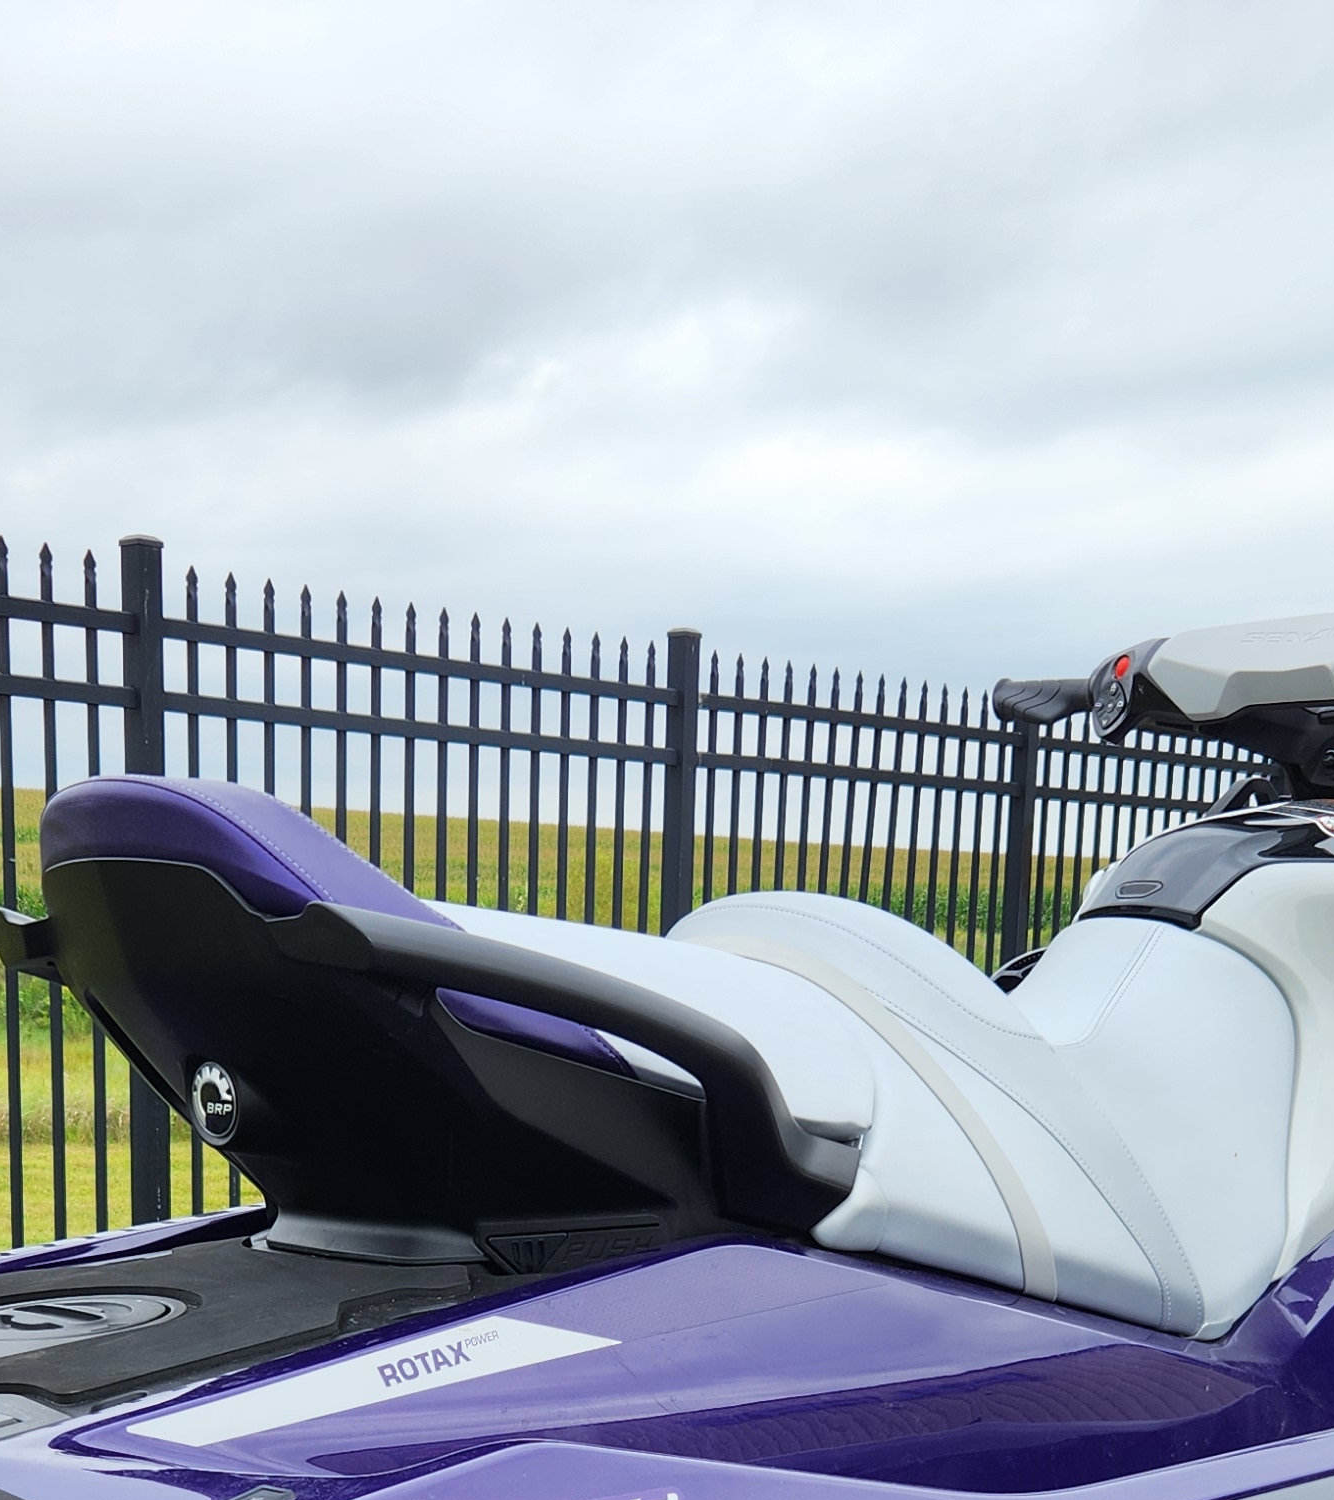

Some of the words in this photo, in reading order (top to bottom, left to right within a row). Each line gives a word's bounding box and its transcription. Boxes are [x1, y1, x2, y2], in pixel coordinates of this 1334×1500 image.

[207, 1102, 232, 1116] BRP
[565, 1235, 654, 1262] PUSH
[376, 1341, 472, 1388] ROTAX
